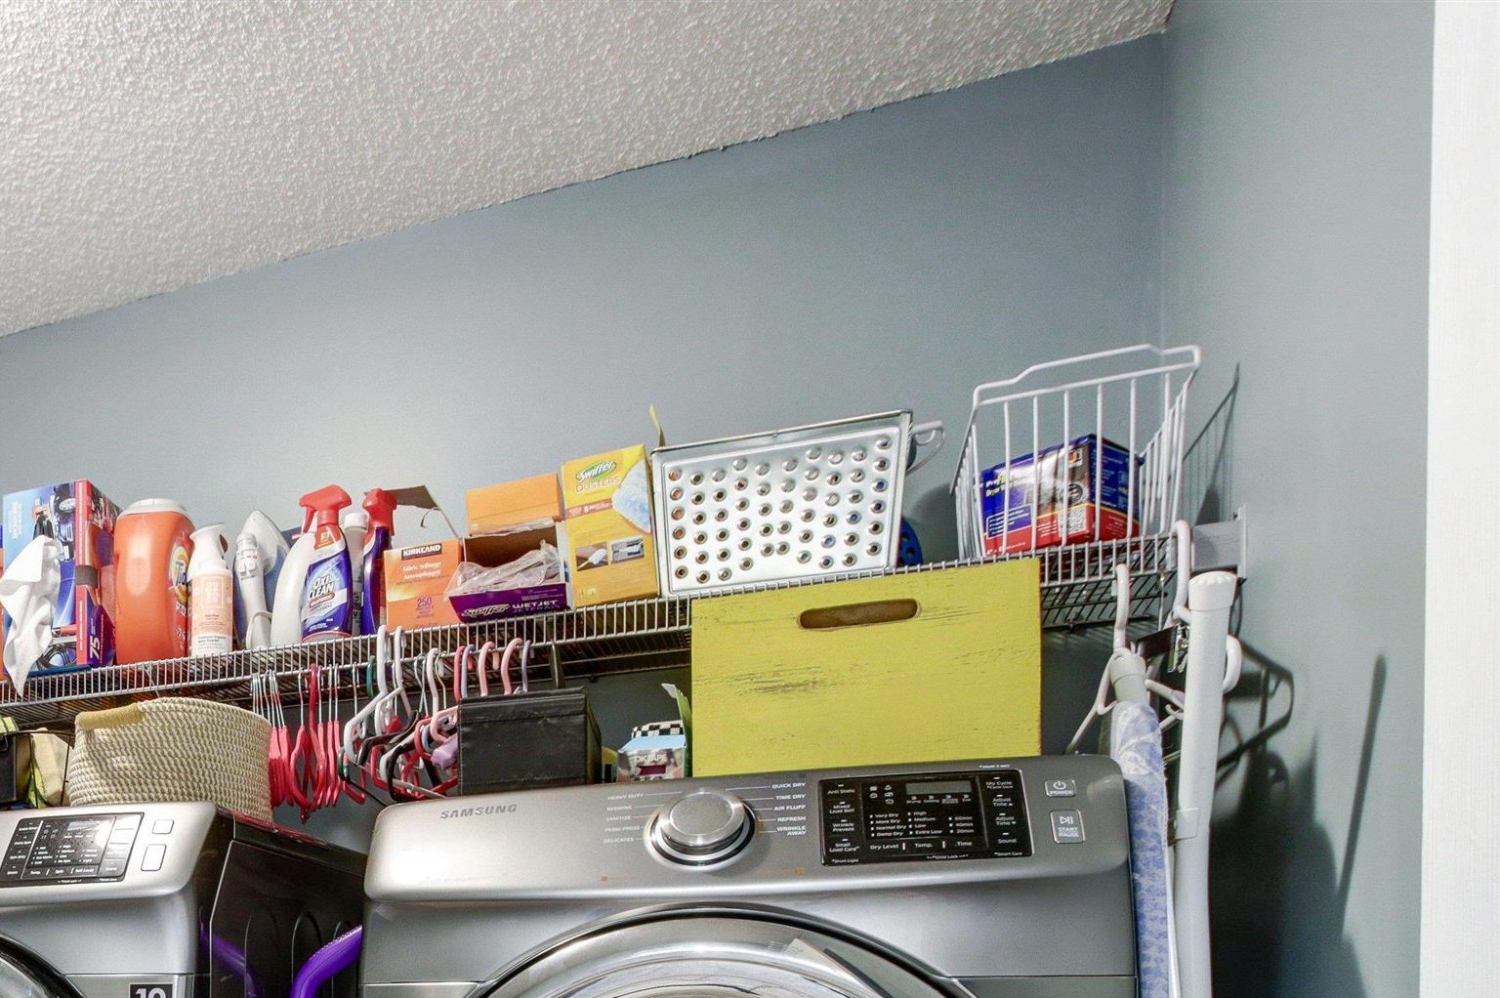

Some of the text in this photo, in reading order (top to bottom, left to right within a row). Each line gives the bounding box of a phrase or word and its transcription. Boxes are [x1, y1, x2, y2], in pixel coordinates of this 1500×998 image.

[576, 461, 617, 482] Swiffer
[575, 476, 621, 493] DUSTERS
[402, 544, 442, 557] KIRKLAND
[175, 561, 187, 587] Tid
[313, 575, 330, 589] OXI
[309, 581, 335, 599] CLEAN
[417, 597, 432, 607] 250
[512, 600, 558, 609] WETJET
[89, 636, 100, 660] 75
[440, 804, 517, 820] SAMSUNG
